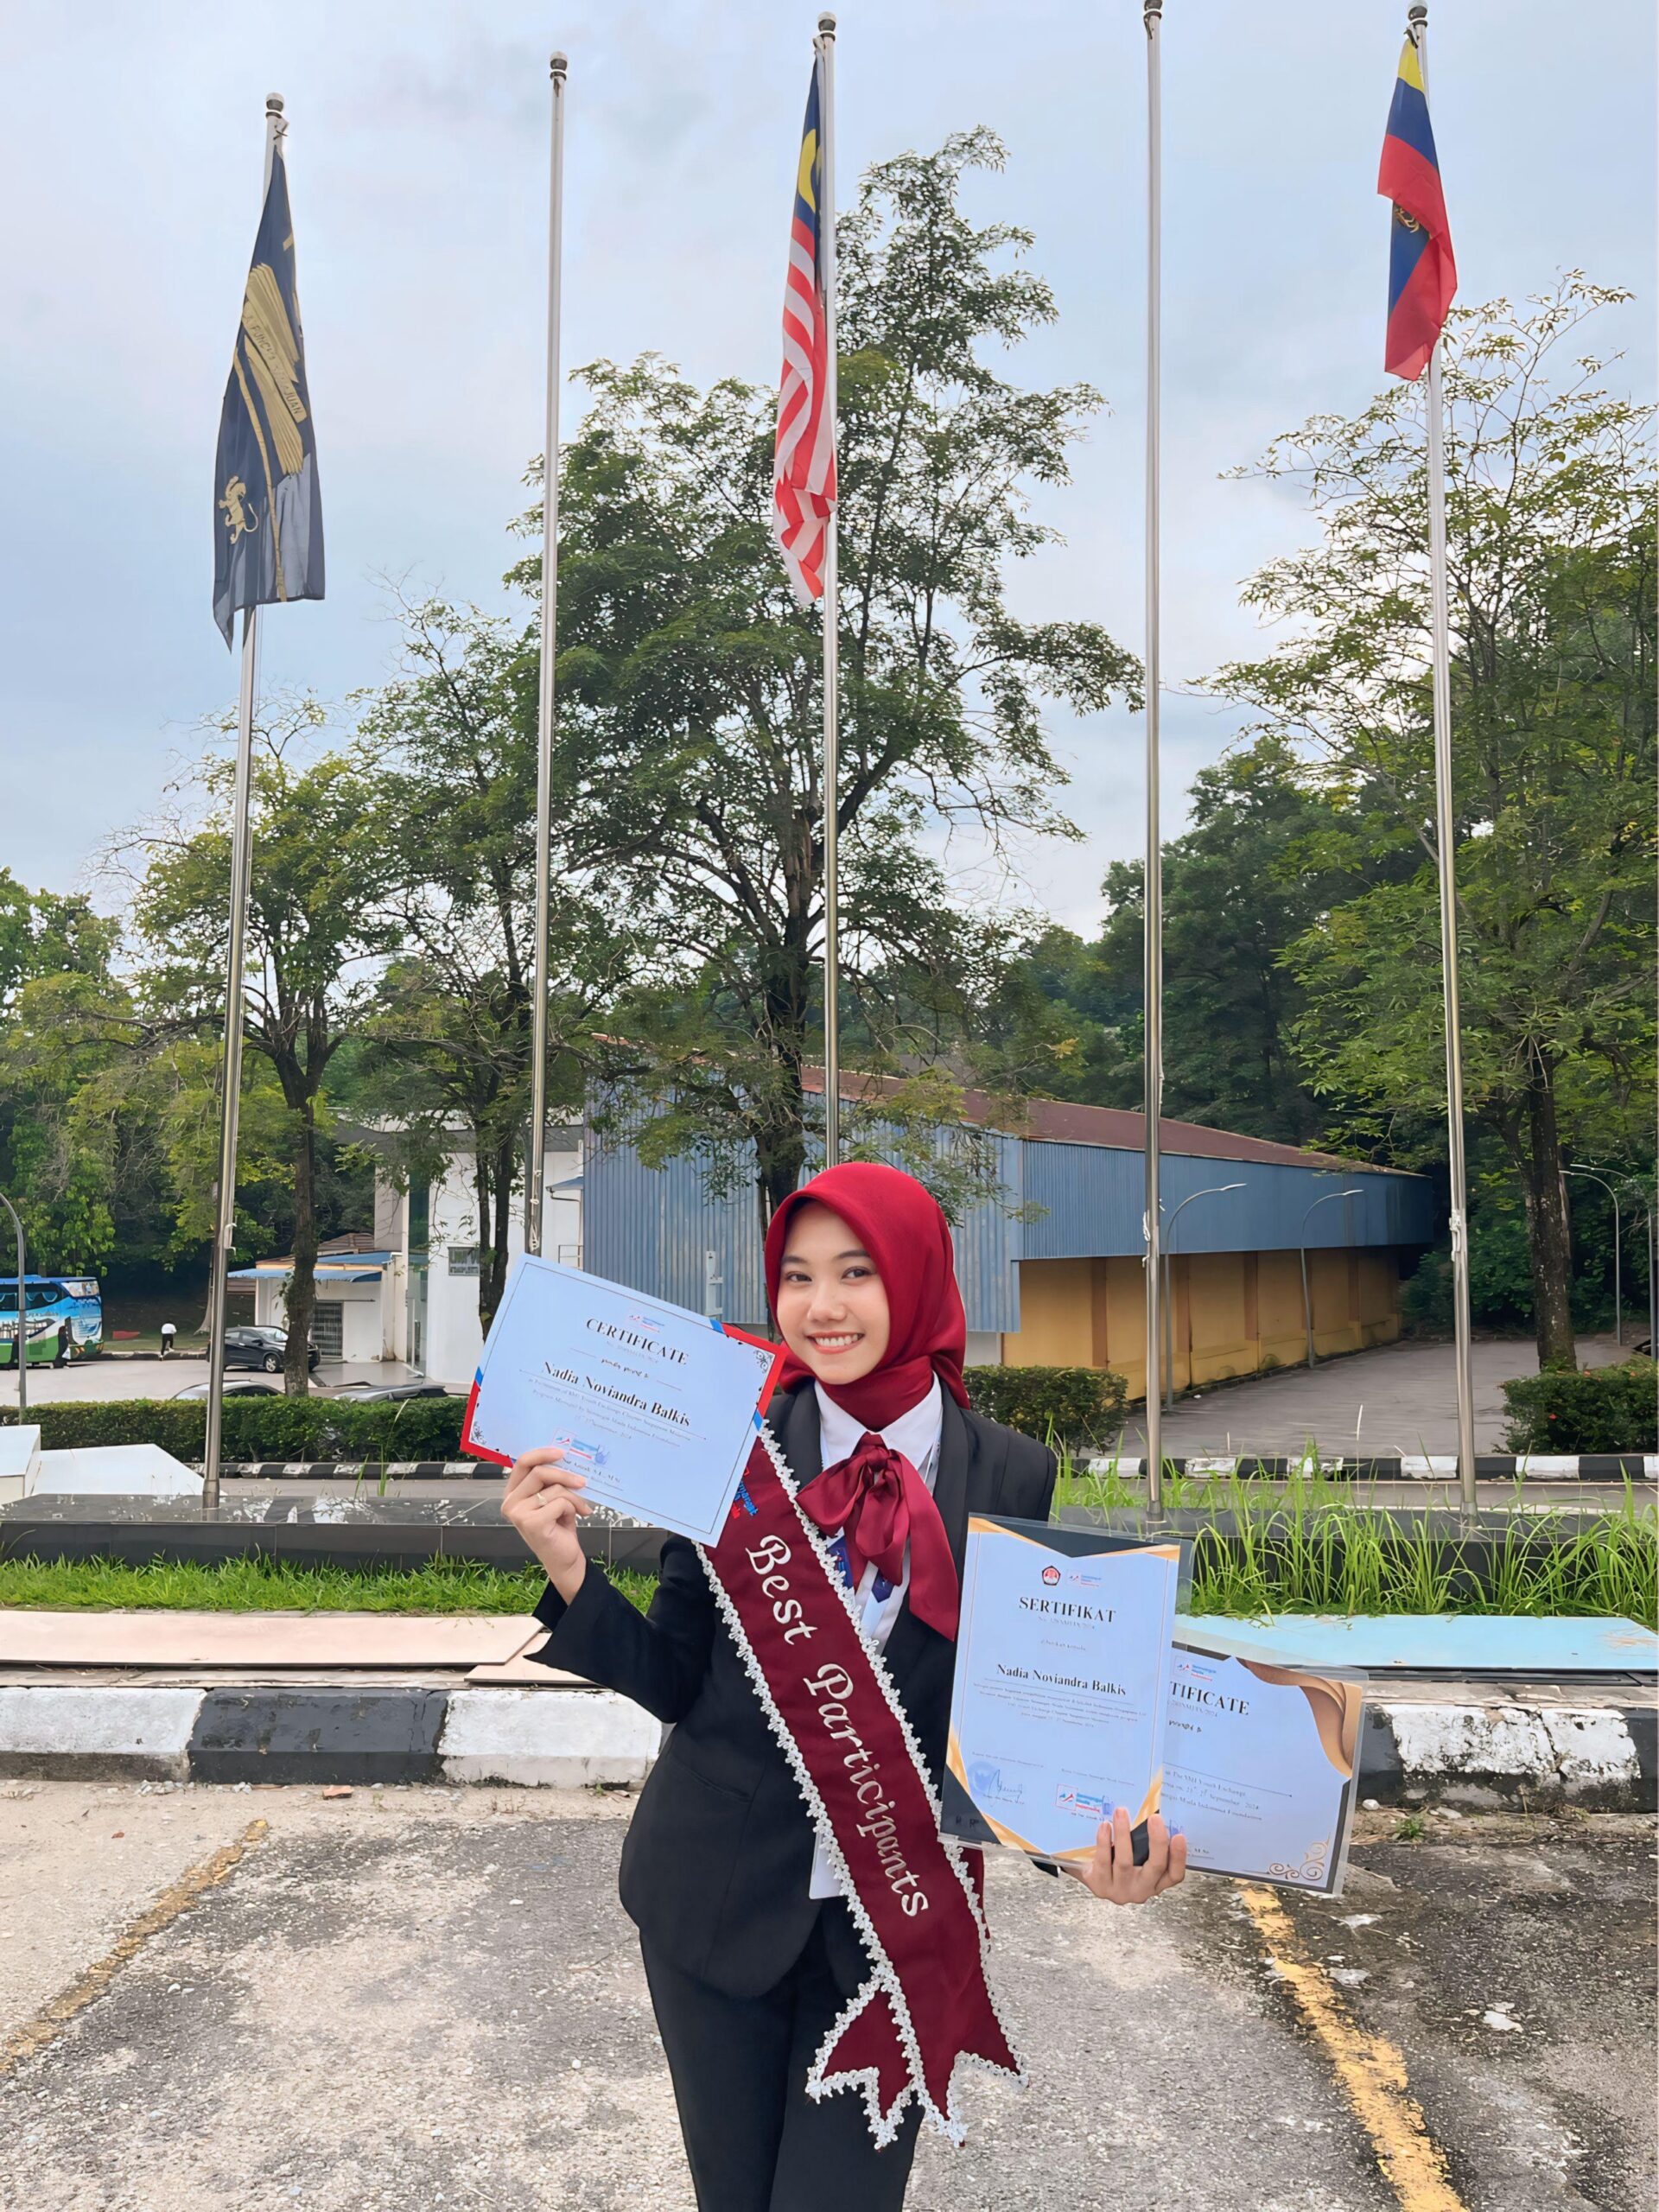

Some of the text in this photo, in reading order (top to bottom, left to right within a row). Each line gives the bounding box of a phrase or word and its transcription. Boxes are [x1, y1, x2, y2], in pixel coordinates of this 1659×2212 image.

[586, 1318, 690, 1365] CERTIFICATE
[541, 1361, 579, 1384] Nadia
[582, 1376, 647, 1411] Noviandra
[651, 1402, 690, 1427] Balkis
[745, 1535, 818, 1645] Best
[1019, 1596, 1116, 1623] SERTIFIKAT
[996, 1663, 1127, 1696] Nadia Noviandra Balkis
[1170, 1681, 1250, 1716] TIFICATE
[803, 1663, 929, 1916] Participants
